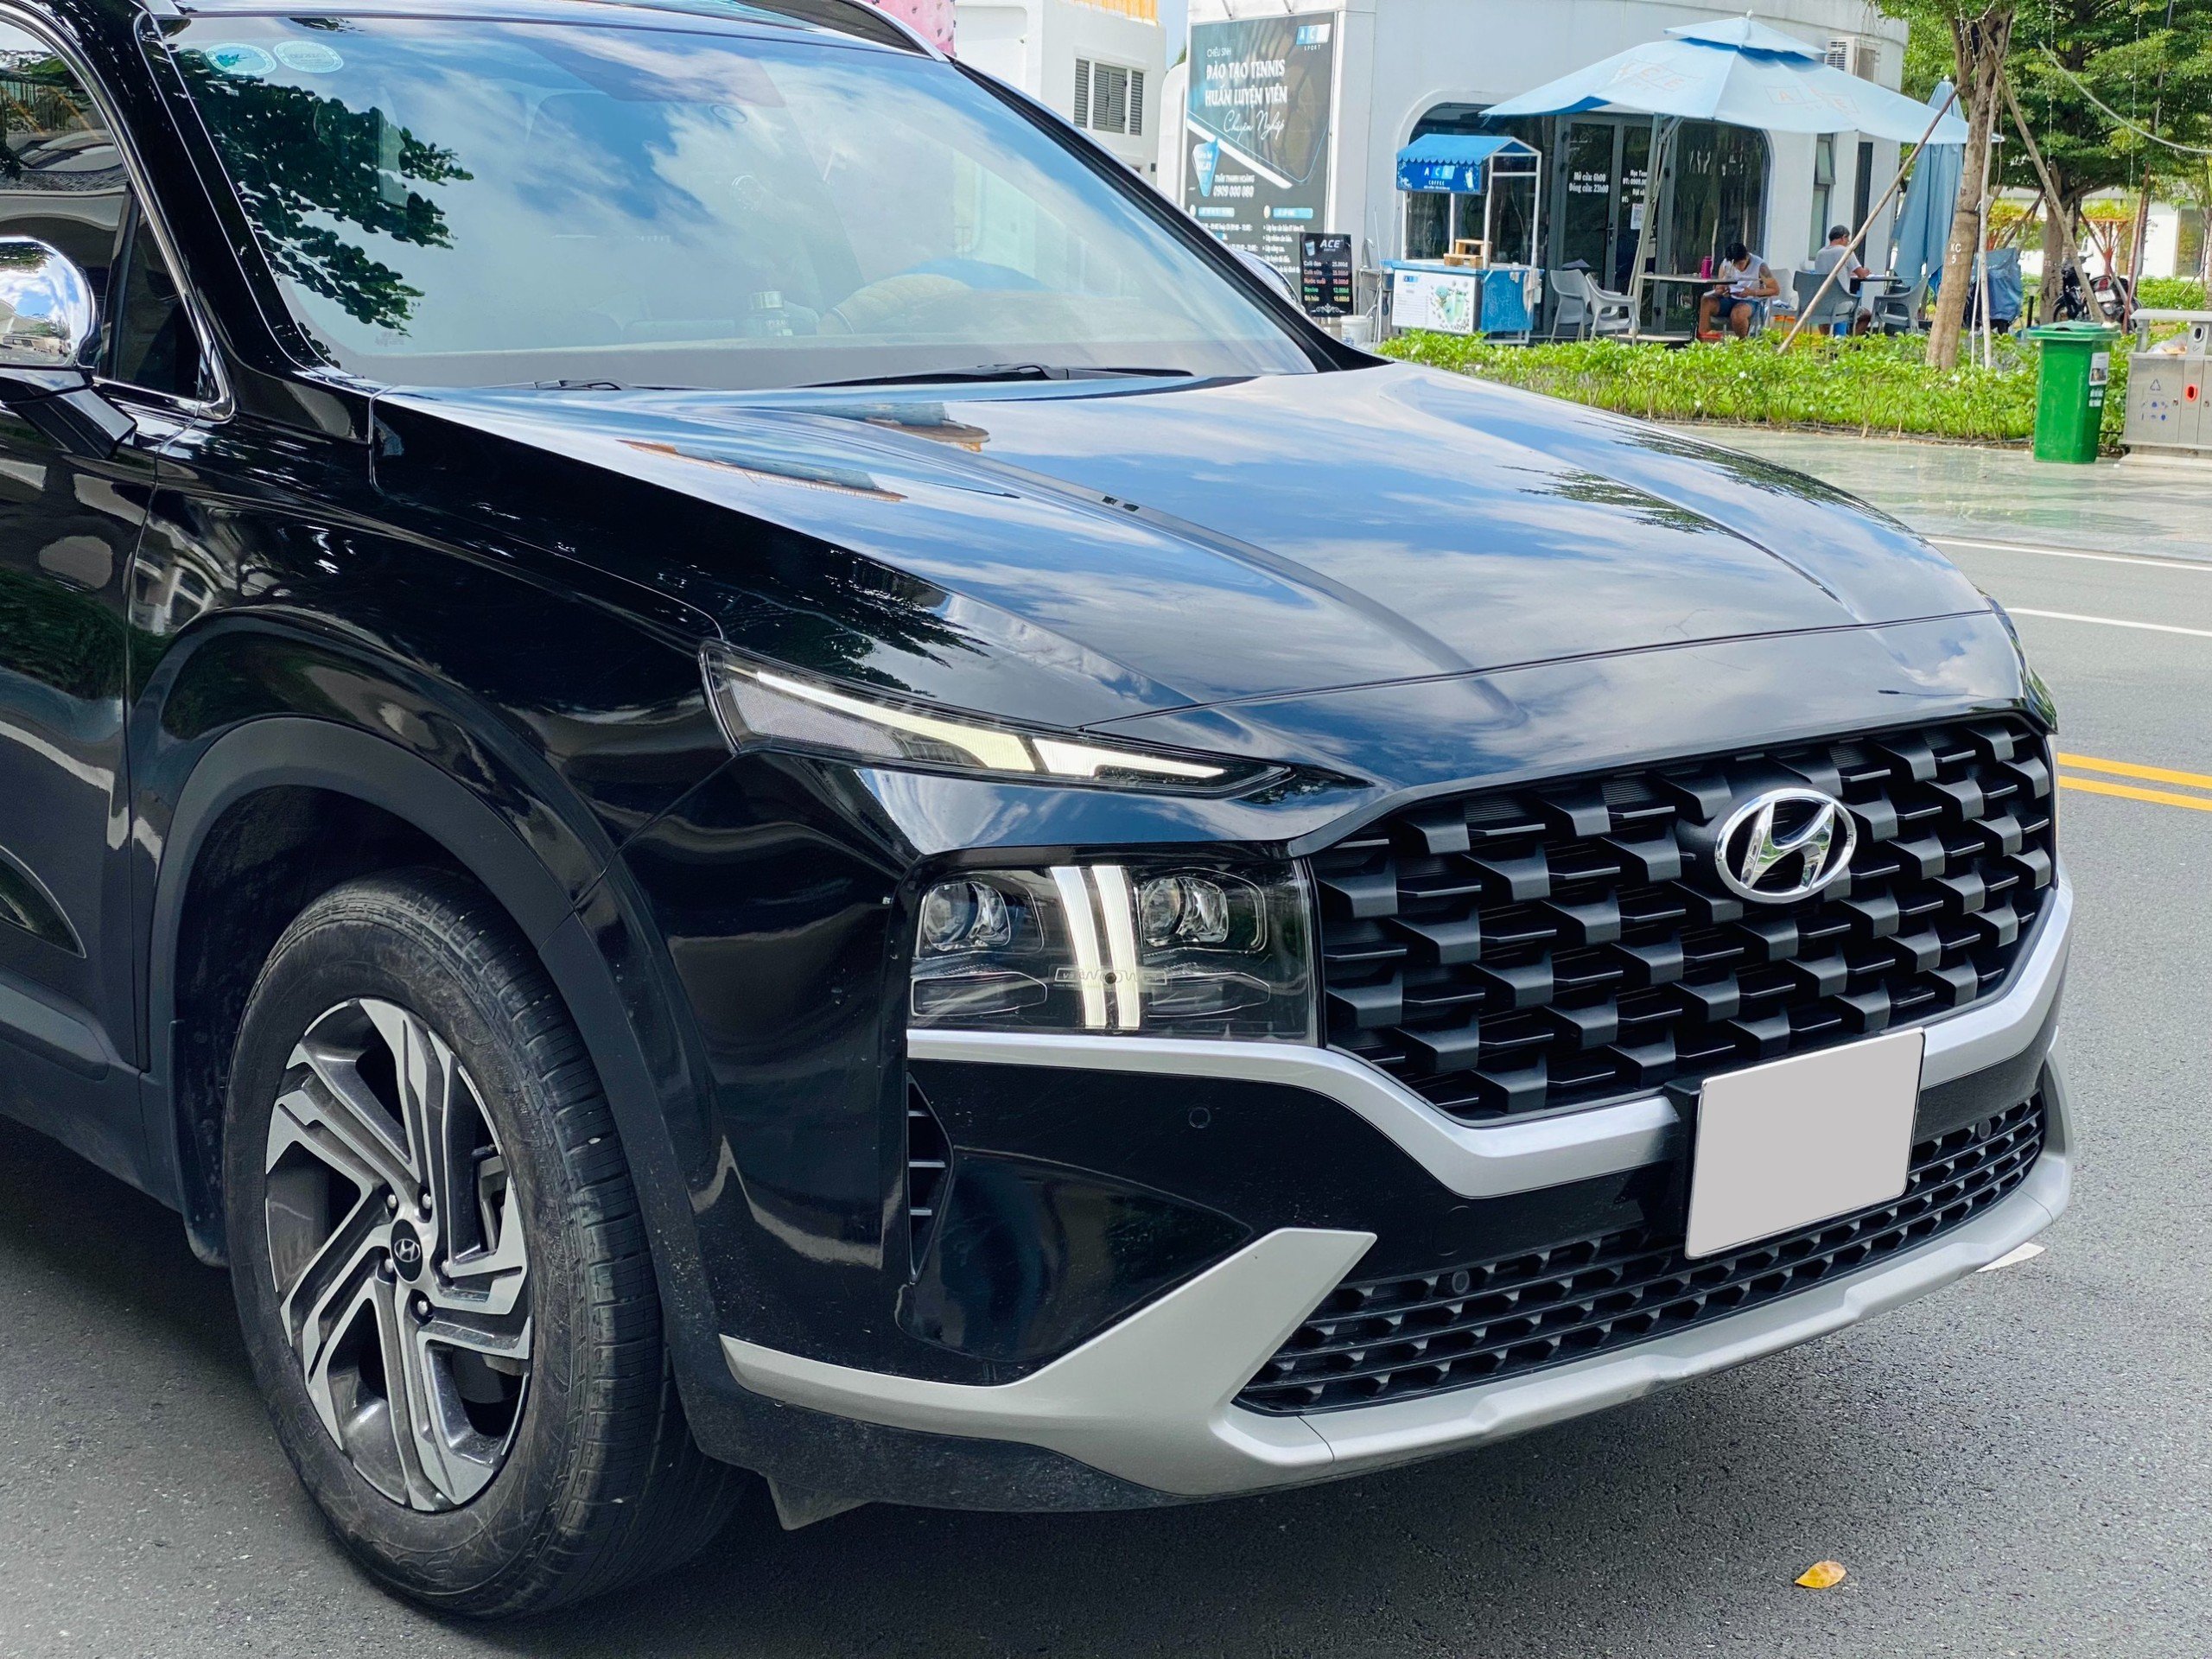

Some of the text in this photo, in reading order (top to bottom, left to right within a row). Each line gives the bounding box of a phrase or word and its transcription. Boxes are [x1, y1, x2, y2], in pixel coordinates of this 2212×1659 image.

[1222, 47, 1232, 56] SINH
[1206, 60, 1226, 80] ĐÀO
[1251, 59, 1286, 79] TENNIS
[1205, 85, 1232, 106] HUẤN
[1264, 82, 1287, 104] VIÊN
[1319, 238, 1341, 249] ACE
[1951, 254, 1957, 264] 5
